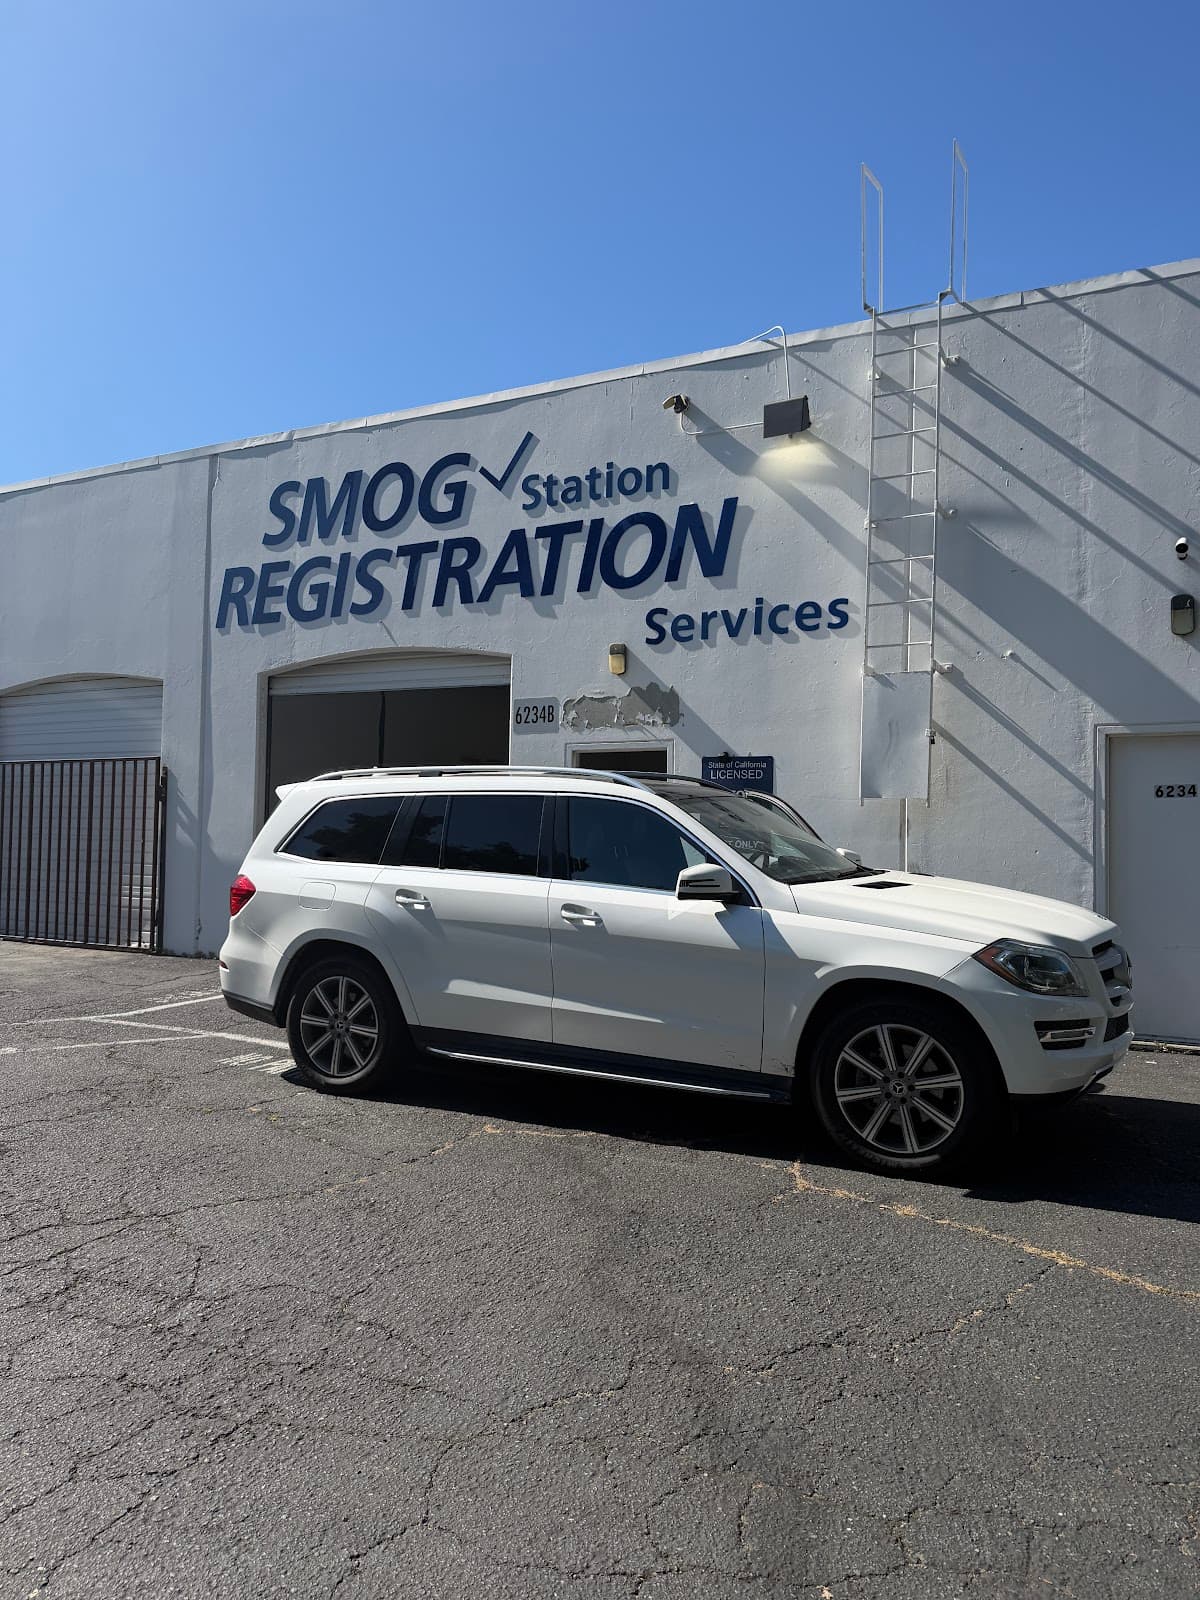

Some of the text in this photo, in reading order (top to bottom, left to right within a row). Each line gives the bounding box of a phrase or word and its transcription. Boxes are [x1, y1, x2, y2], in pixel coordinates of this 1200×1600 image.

[262, 452, 670, 547] SMOG Station
[216, 497, 738, 629] REGISTRATION
[645, 597, 849, 645] Services
[515, 704, 555, 725] 6234B
[708, 760, 767, 769] State of California
[710, 769, 763, 780] LICENSED
[1155, 784, 1197, 798] 6234
[734, 839, 760, 849] ONLY
